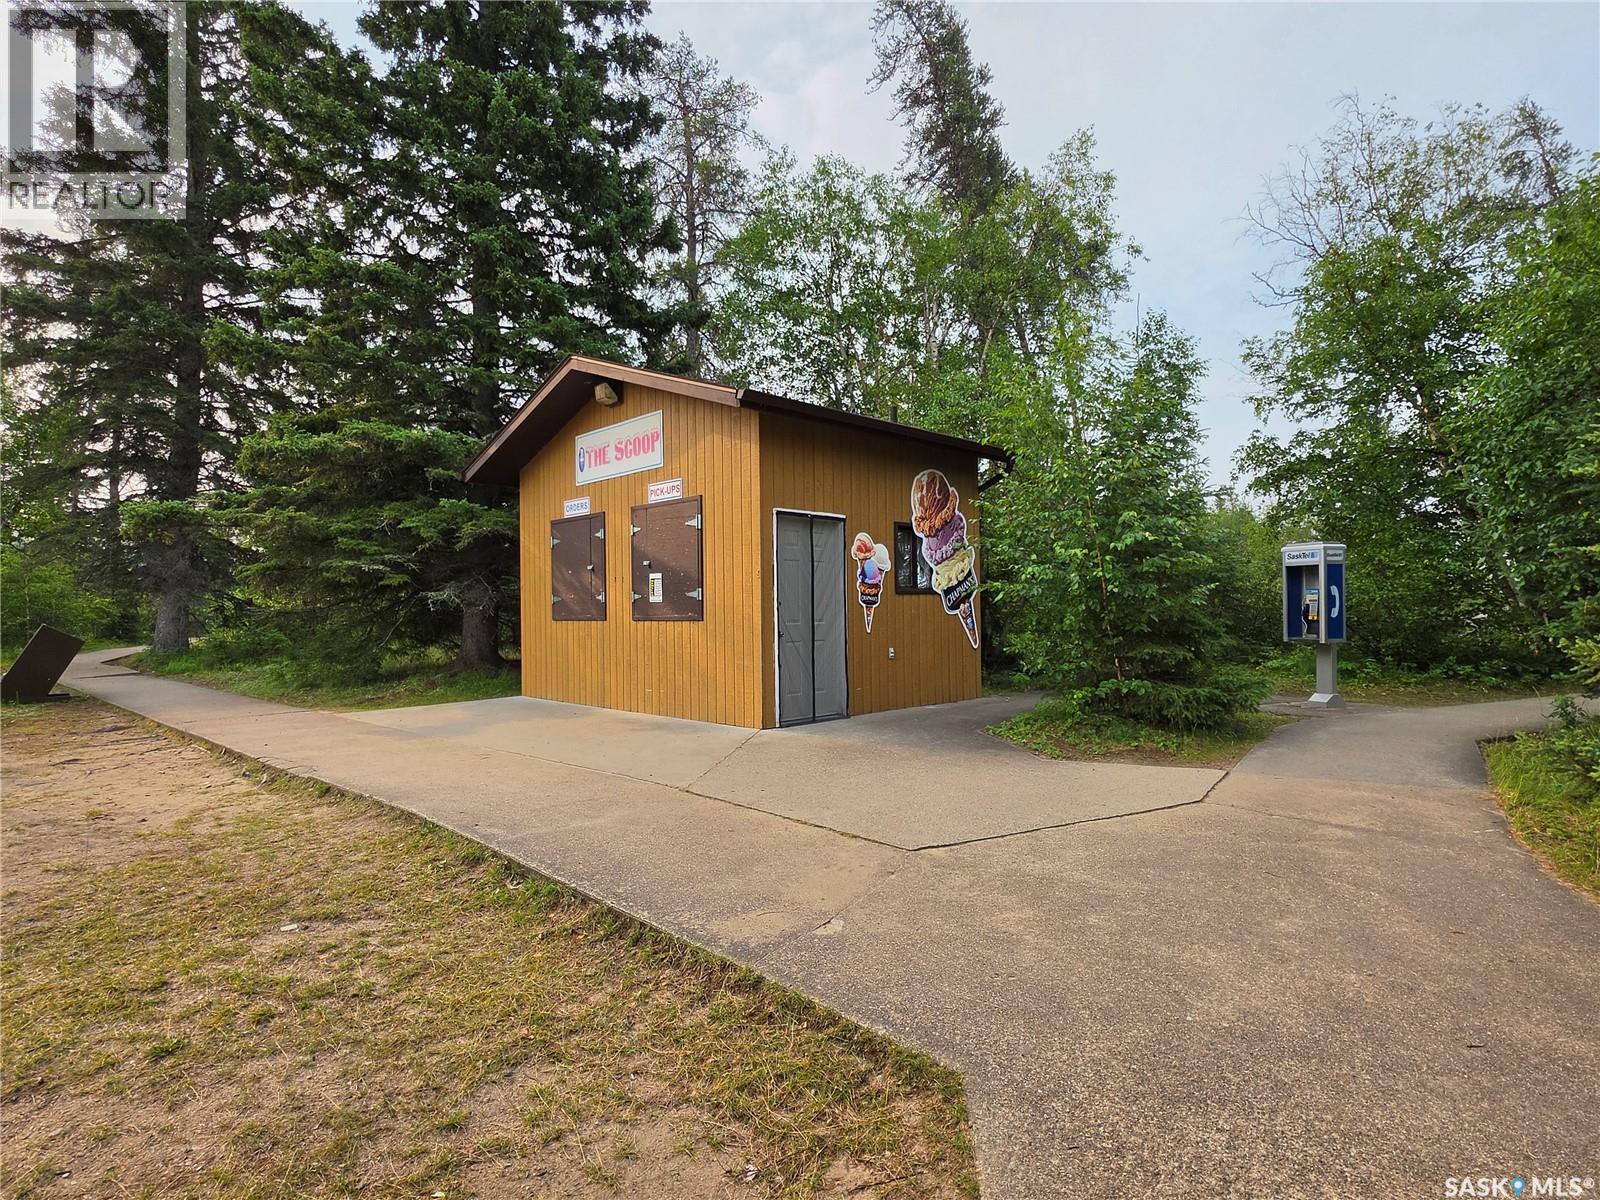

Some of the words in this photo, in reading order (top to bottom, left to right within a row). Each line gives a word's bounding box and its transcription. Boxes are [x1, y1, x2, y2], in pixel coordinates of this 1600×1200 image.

[586, 443, 611, 468] THE
[614, 429, 660, 461] SCOOP
[650, 484, 681, 498] PICK-UPS
[565, 501, 588, 513] ORDERS
[1286, 551, 1311, 560] SaskTel
